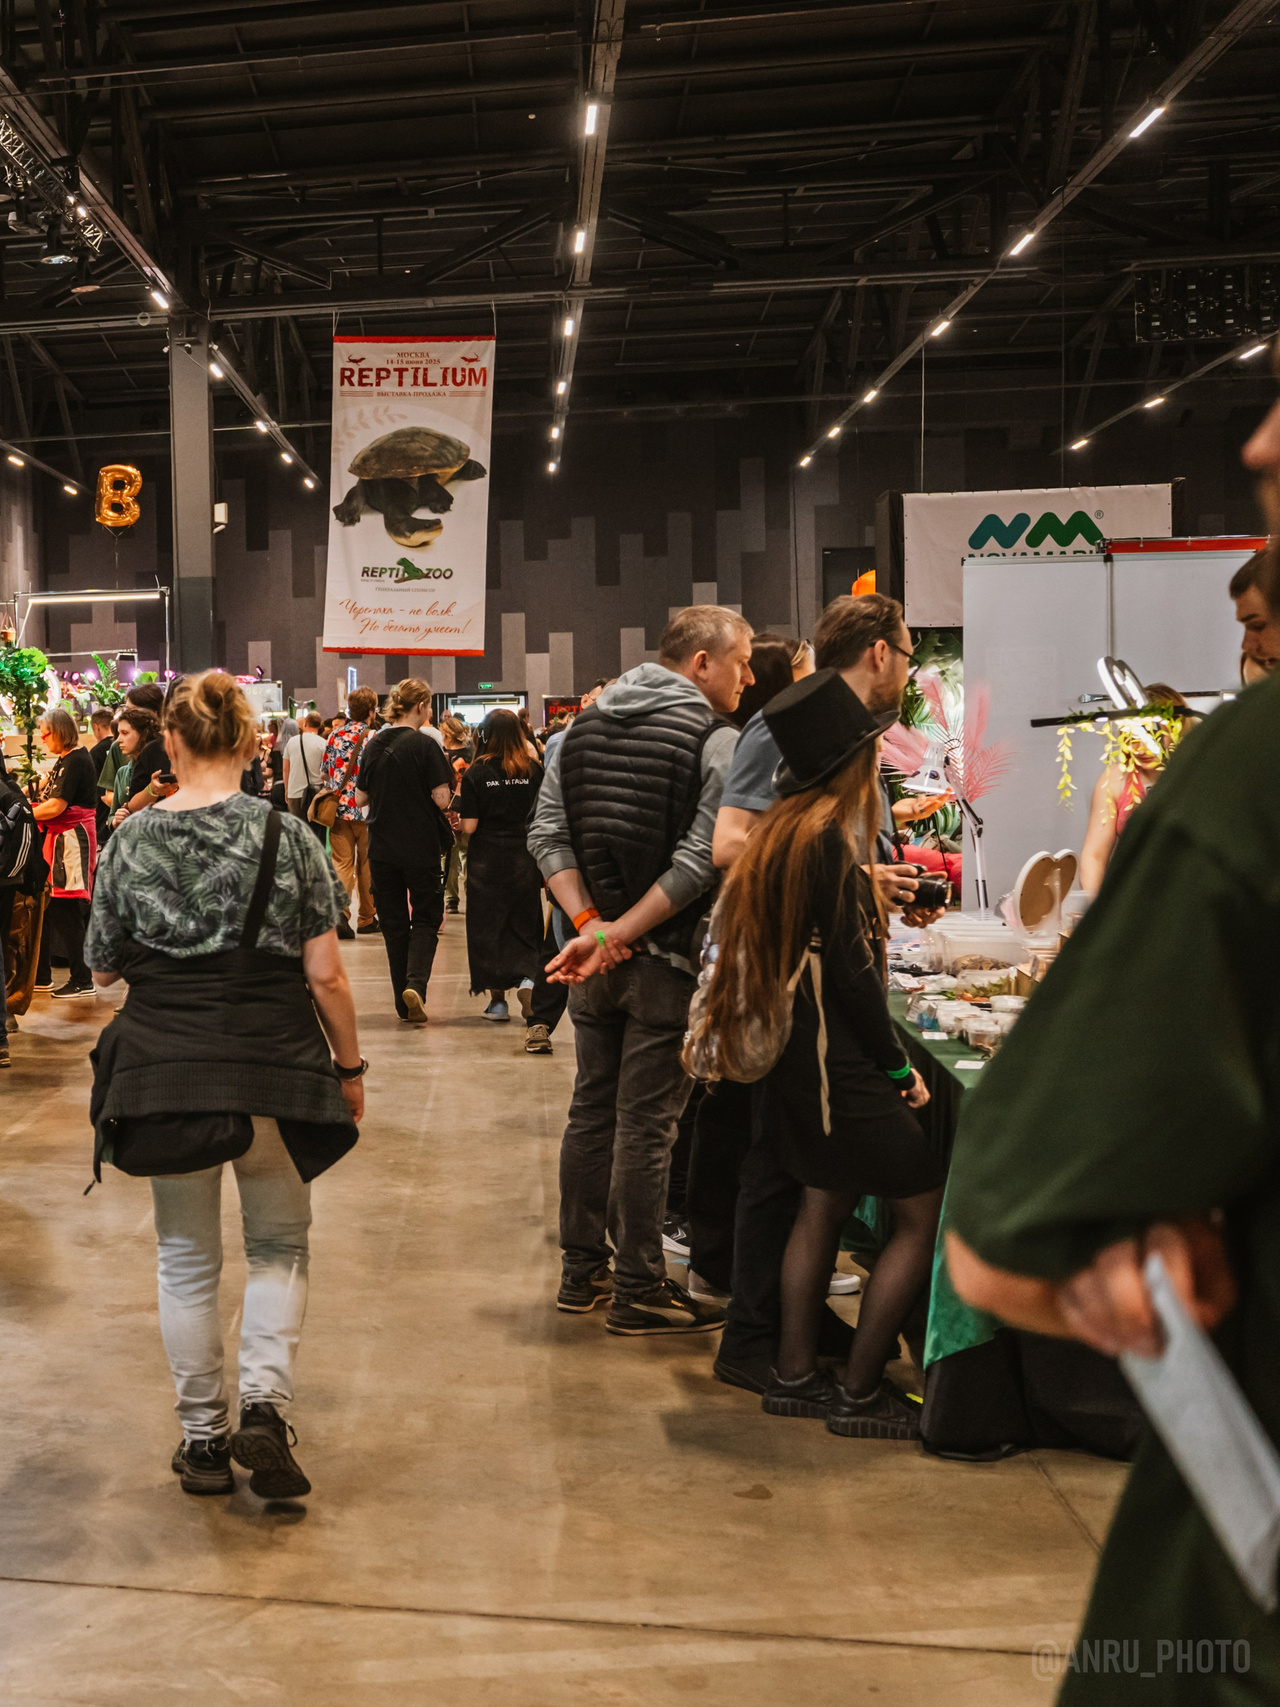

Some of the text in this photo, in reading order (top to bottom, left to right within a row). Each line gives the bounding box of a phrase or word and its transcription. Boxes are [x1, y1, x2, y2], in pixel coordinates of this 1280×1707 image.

[339, 367, 487, 387] REPTILIUM
[339, 598, 394, 620] Черепаха
[359, 618, 379, 635] Но
[383, 619, 420, 633] бегать
